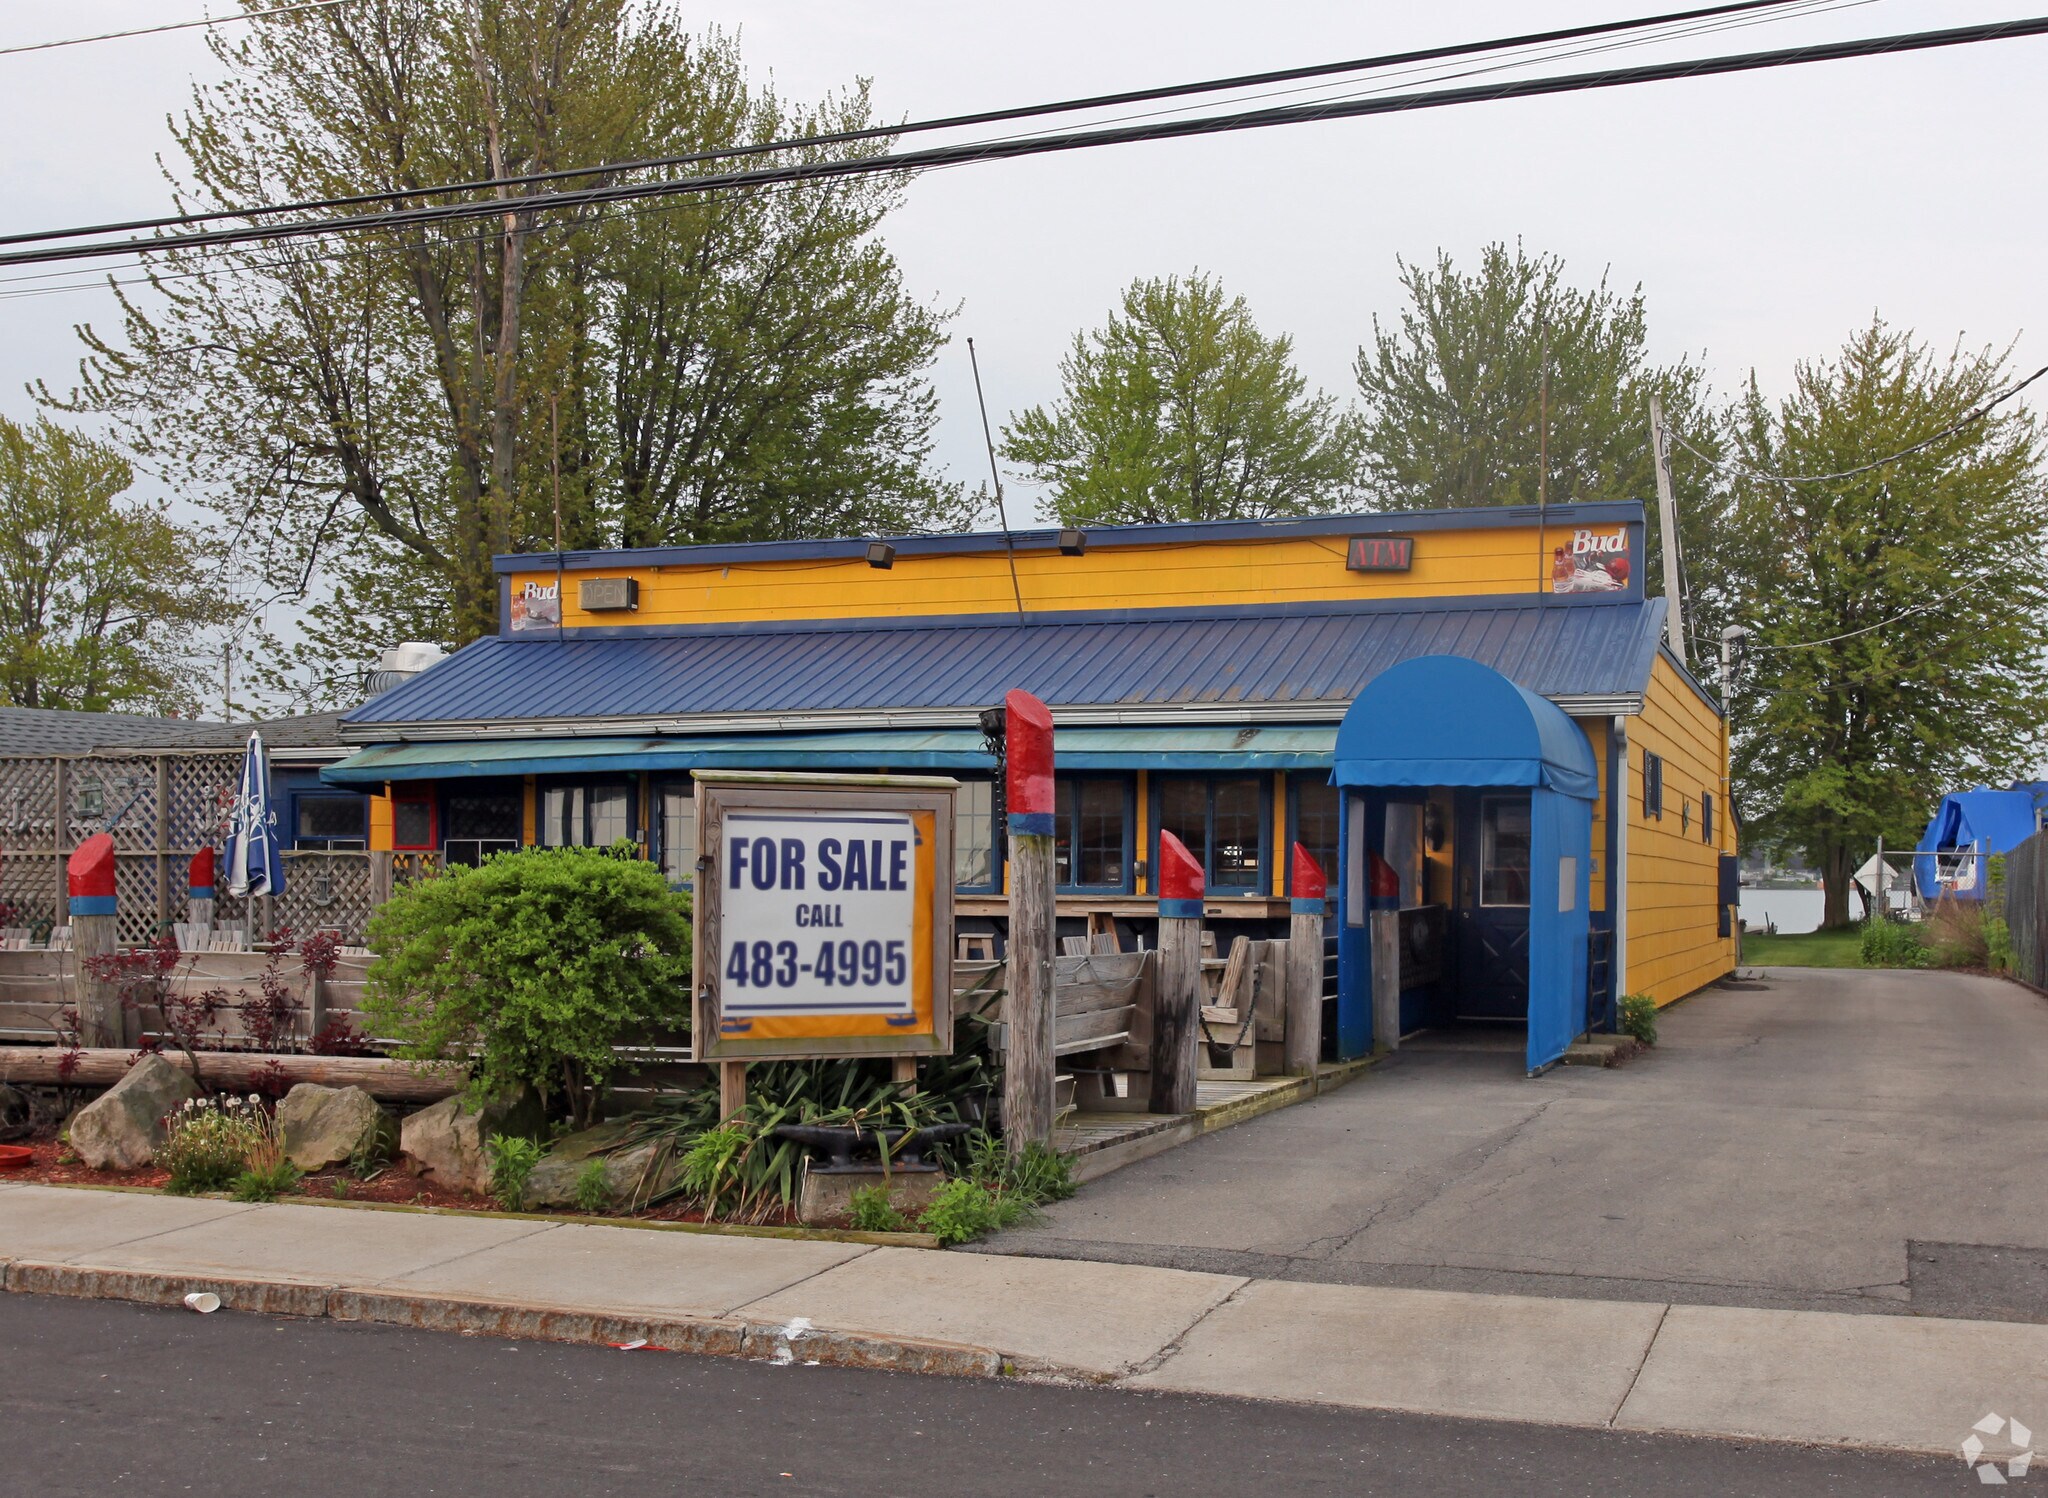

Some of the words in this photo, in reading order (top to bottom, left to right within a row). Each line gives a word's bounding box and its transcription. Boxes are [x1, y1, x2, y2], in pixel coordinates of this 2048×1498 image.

[1351, 540, 1407, 568] ATM
[1573, 527, 1626, 554] Bud
[524, 580, 559, 601] Bud
[583, 584, 626, 605] OPEN
[729, 837, 806, 891] FOR
[817, 837, 908, 892] SALE
[795, 903, 844, 928] CALL
[726, 939, 907, 988] 483-4995
